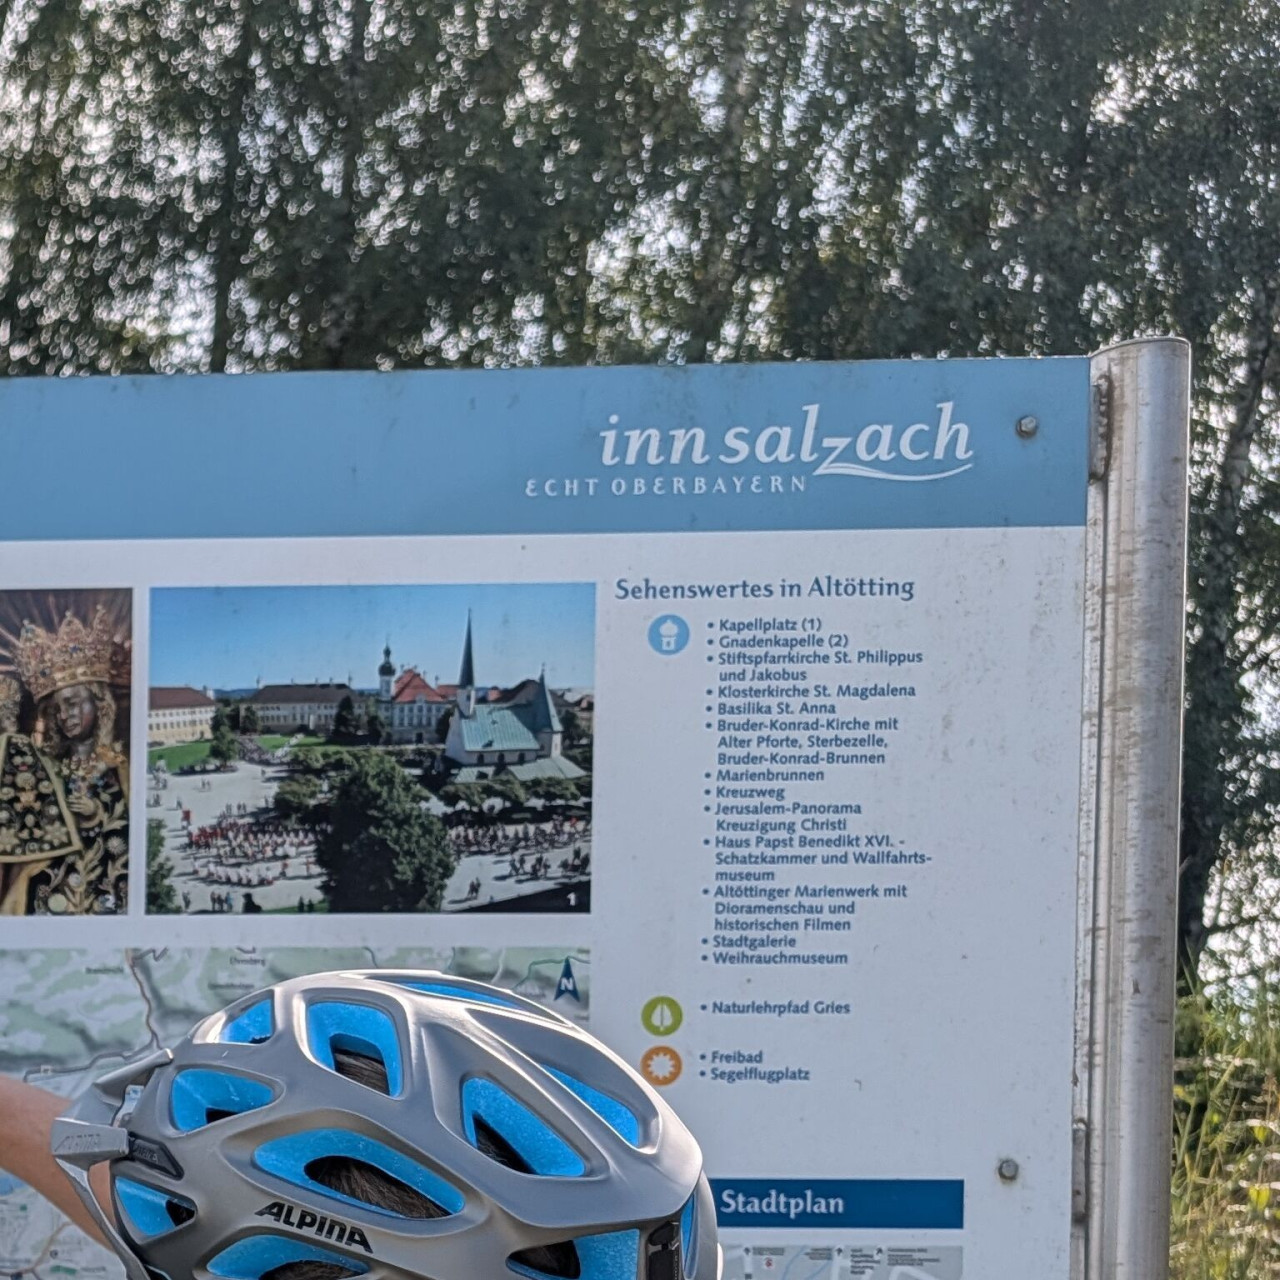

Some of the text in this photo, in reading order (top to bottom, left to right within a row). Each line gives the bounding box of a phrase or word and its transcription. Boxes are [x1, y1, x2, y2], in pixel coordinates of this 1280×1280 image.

[525, 476, 807, 496] ECHT OBERBAYERN
[615, 576, 915, 601] Sehenswertes in Altötting
[719, 618, 822, 634] Kapellplatz (1)
[719, 635, 849, 651] Gnadenkapelle (2)
[718, 650, 923, 668] Stiftspfarrkirche St. Philippus
[719, 669, 807, 682] und Jakobus
[718, 684, 916, 701] Klosterkirche St. Magdalena
[718, 702, 836, 715] Basilika St. Anna
[718, 718, 898, 732] Bruder-Konrad-Kirche mit
[718, 735, 888, 750] Alter Pforte, Sterbezelle,
[718, 752, 885, 765] Bruder-Konrad-Brunnen
[717, 768, 824, 782] Marienbrunnen
[716, 786, 785, 801] Kreuzweg
[714, 802, 862, 816] Jerusalem-Panorama
[716, 818, 847, 835] Kreuzigung Christi
[715, 835, 893, 852] Haus Papst Benedikt XVI.
[715, 851, 932, 865] Schatzkammer und Wallfahrts-
[715, 870, 775, 882] museum
[567, 892, 576, 906] 1
[713, 884, 908, 900] Altöttinger Marienwerk mit
[715, 902, 855, 915] Dioramenschau und
[714, 918, 851, 932] historischen Filmen
[713, 935, 796, 950] Stadtgalerie
[713, 951, 848, 965] Weihrauchmuseum
[561, 977, 573, 990] N
[712, 1001, 851, 1017] Naturlehrpfad Gries
[711, 1051, 763, 1064] Freibad
[710, 1067, 810, 1083] Segelflugplatz
[720, 1189, 845, 1219] Stadtplan
[254, 1202, 373, 1254] ALPINA
